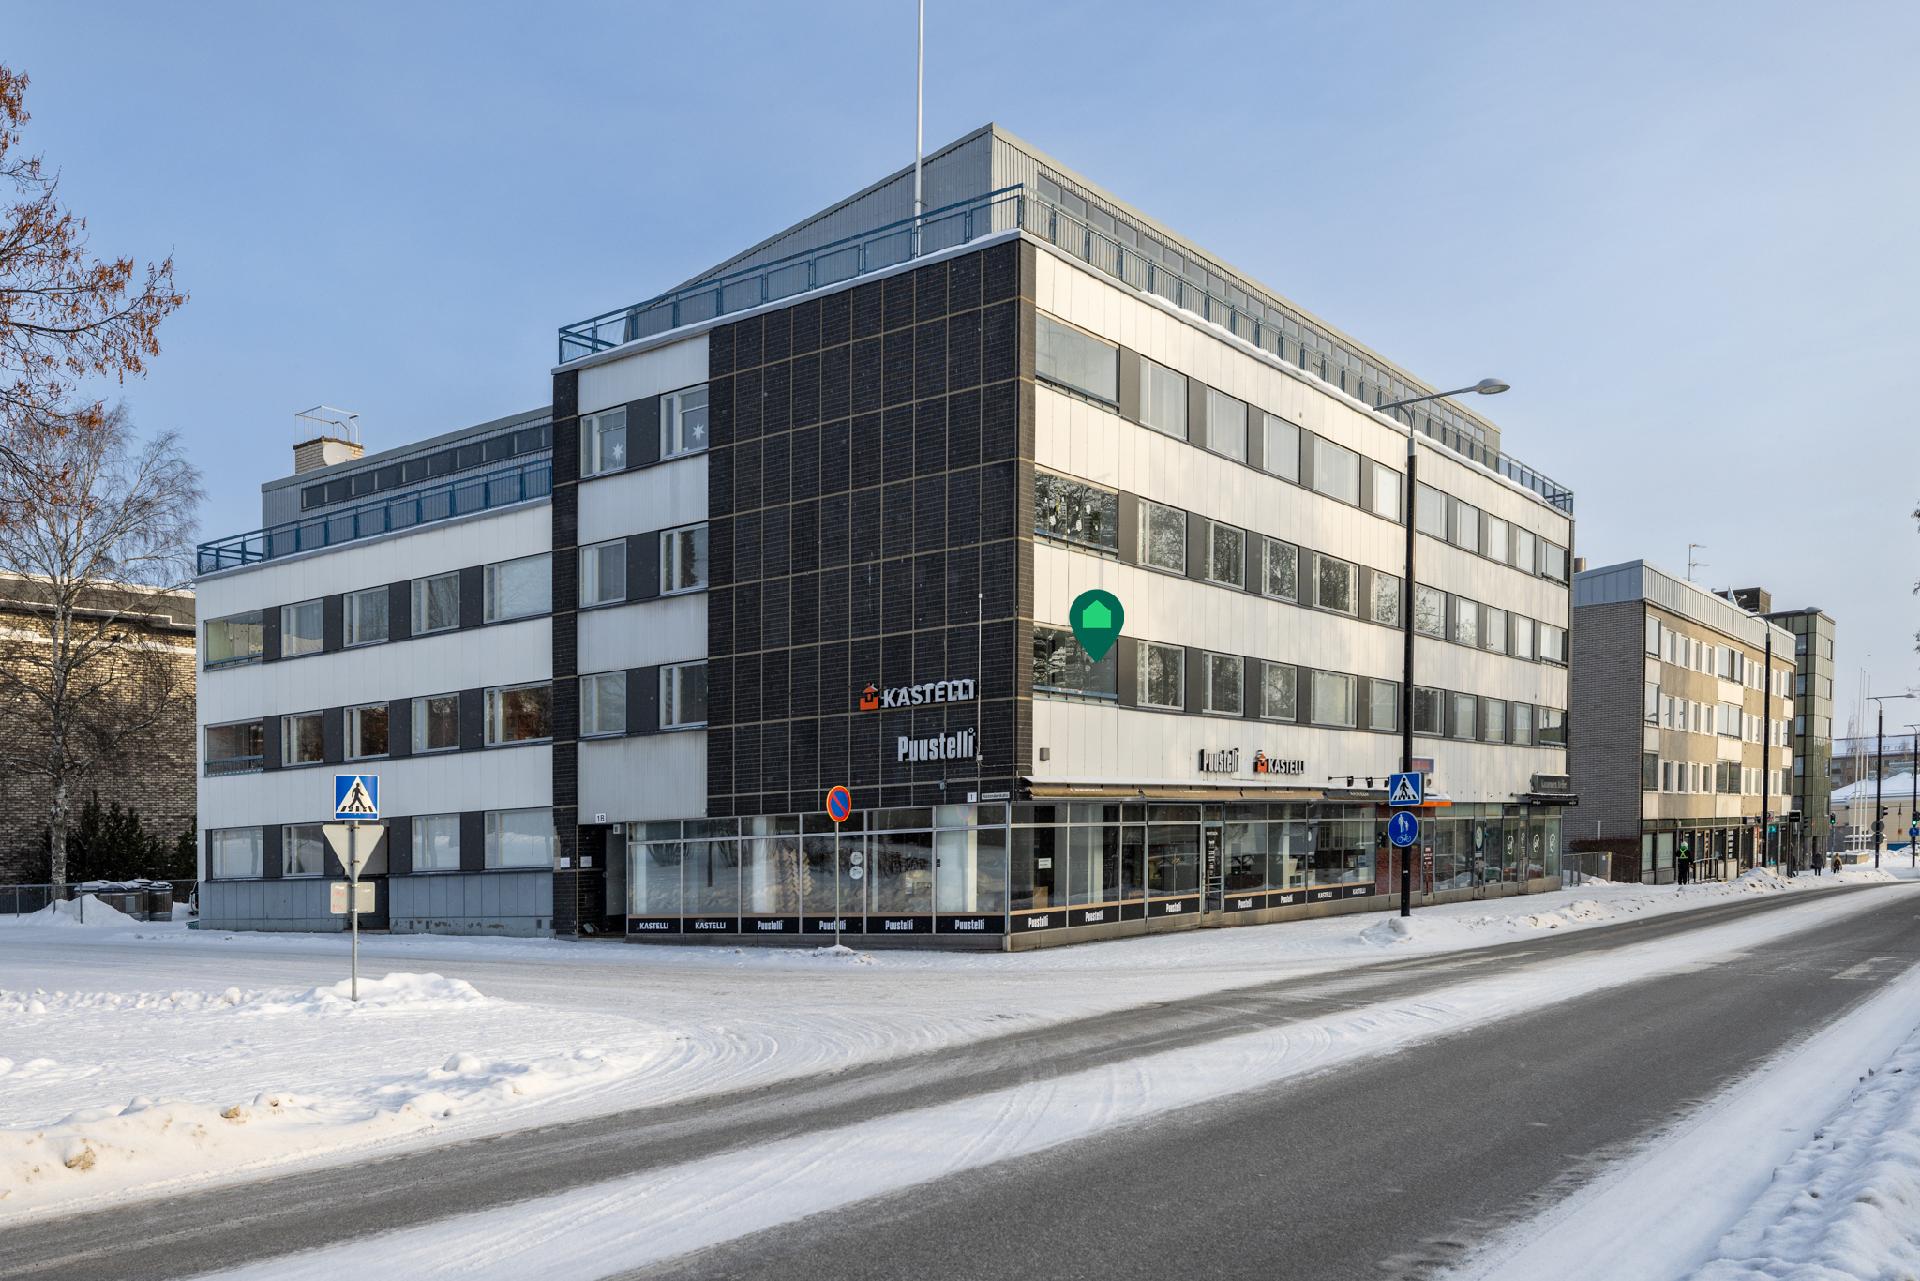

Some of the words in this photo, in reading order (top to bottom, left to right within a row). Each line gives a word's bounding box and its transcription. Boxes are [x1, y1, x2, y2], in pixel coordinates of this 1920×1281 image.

[881, 679, 976, 708] KASTELLI
[897, 727, 976, 761] Puustelli
[695, 921, 726, 929] KASTELLI
[757, 920, 783, 930] Puustelli
[819, 920, 846, 930] Puustlli
[885, 919, 913, 930] Puustelli
[954, 918, 985, 930] Puustelli
